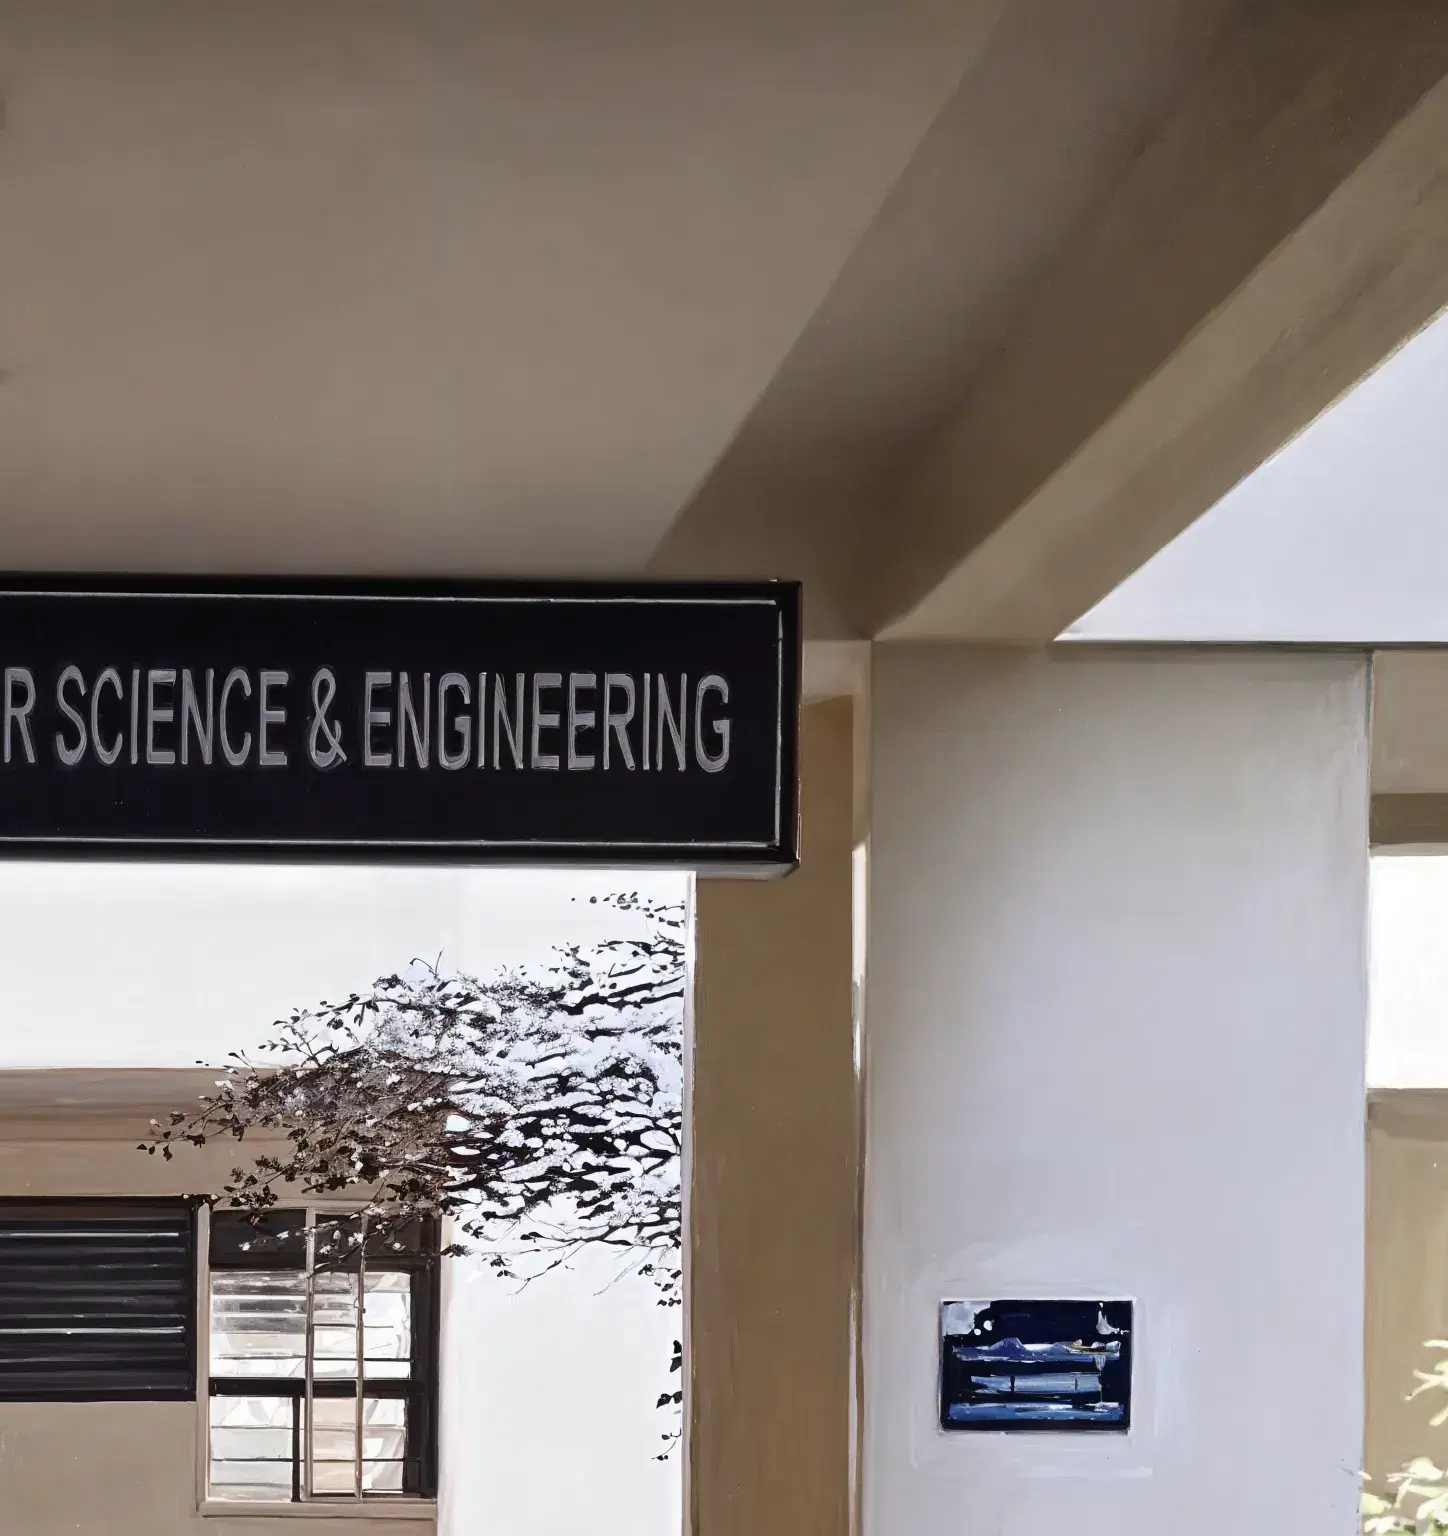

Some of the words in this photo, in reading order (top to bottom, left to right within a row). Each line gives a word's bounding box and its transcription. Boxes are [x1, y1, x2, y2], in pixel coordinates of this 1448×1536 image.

[55, 665, 290, 766] SCIENCE
[306, 668, 348, 768] &
[363, 671, 731, 774] ENGINEERING
